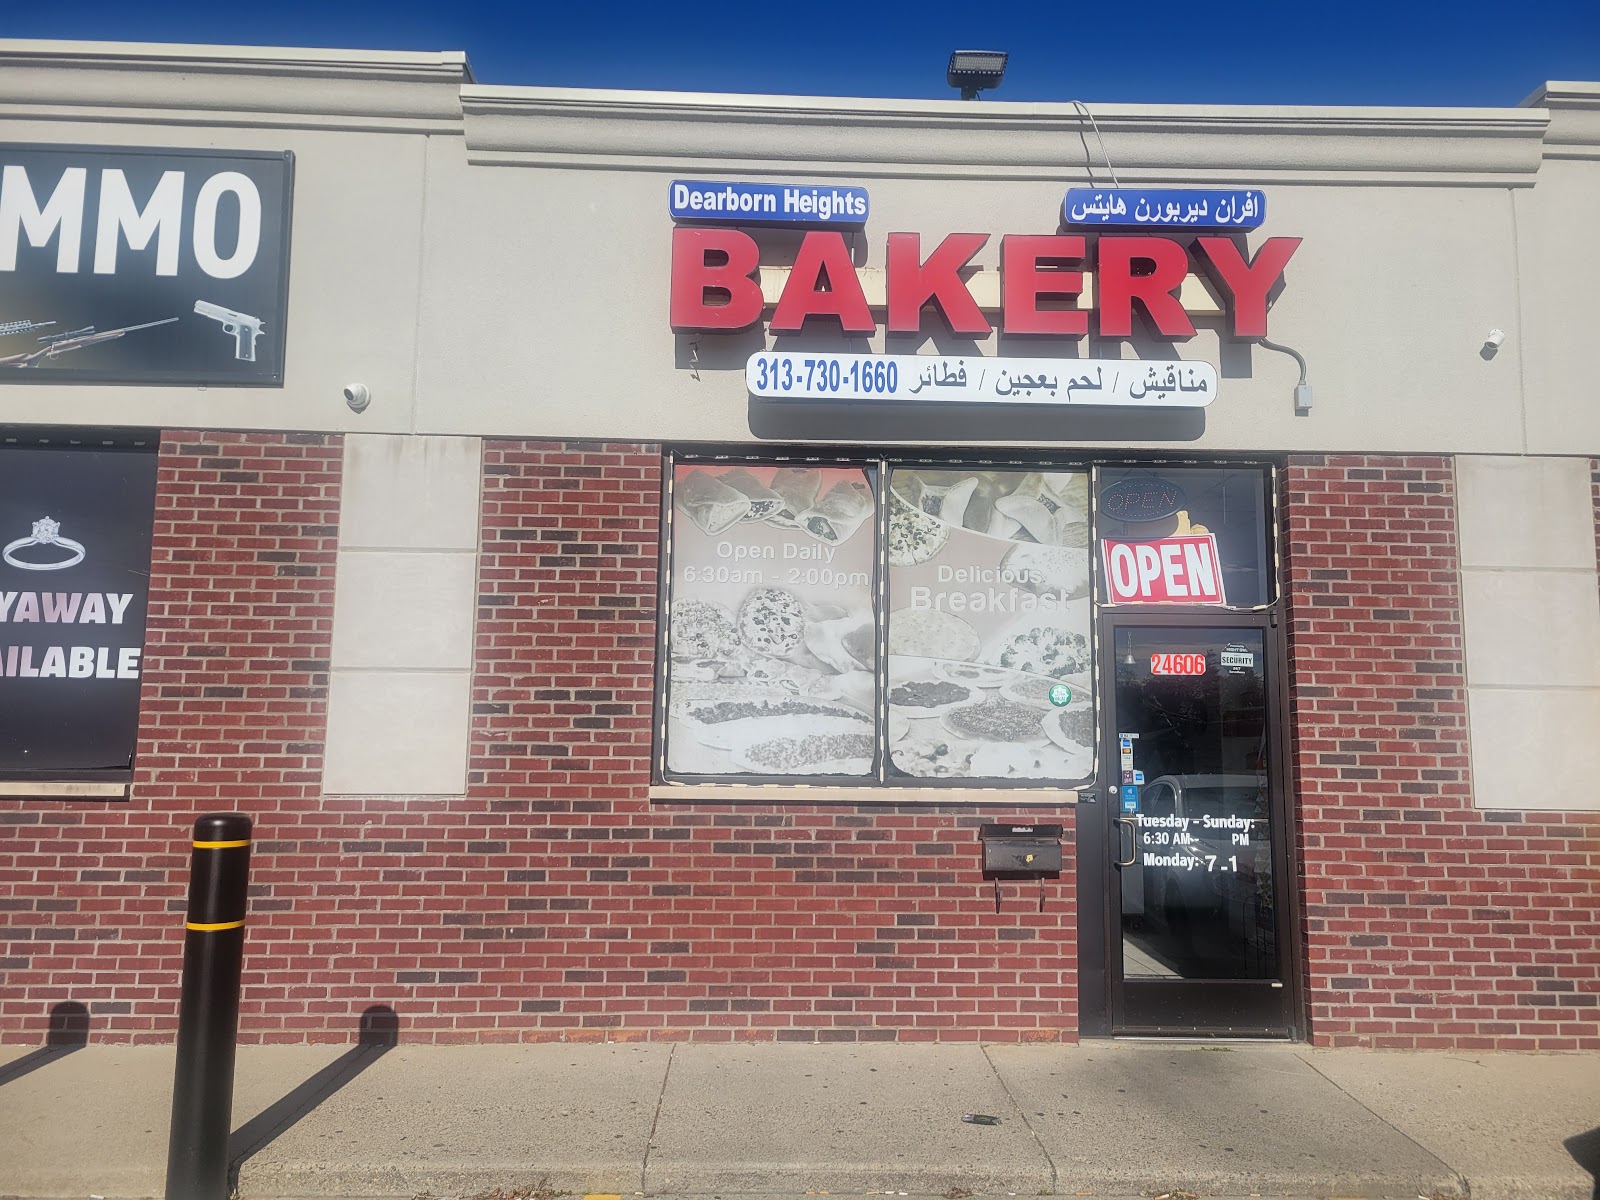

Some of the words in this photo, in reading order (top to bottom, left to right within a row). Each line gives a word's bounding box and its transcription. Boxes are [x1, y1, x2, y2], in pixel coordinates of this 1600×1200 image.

[674, 184, 777, 213] Dearborn
[784, 189, 867, 220] Heights
[1071, 194, 1127, 221] هايتس
[1135, 197, 1208, 223] ديربورن
[1215, 192, 1259, 224] افران
[0, 166, 262, 279] MMO
[670, 225, 1304, 338] BAKERY
[756, 357, 898, 394] 313-730-1660
[909, 359, 967, 394] فطائر
[995, 369, 1058, 398] بعجين
[1066, 366, 1103, 402] لحم
[1129, 364, 1208, 400] مناقيش
[1107, 490, 1178, 512] OPEN
[716, 541, 775, 563] Open
[783, 543, 837, 564] Daily
[683, 566, 763, 584] 6:30am
[787, 568, 869, 590] 2:00pm
[937, 565, 1043, 584] Delicious
[1110, 542, 1217, 598] OPEN
[0, 591, 134, 624] YAWAY
[910, 586, 1071, 613] Breakfast
[0, 645, 141, 679] ILABLE
[1151, 654, 1205, 675] 24606
[1221, 656, 1253, 665] SECURITY
[1136, 813, 1189, 832] Tuesday
[1203, 814, 1255, 833] Sunday:
[1143, 832, 1169, 845] 6:30
[1231, 833, 1249, 846] PM
[1143, 852, 1199, 871] Monday:
